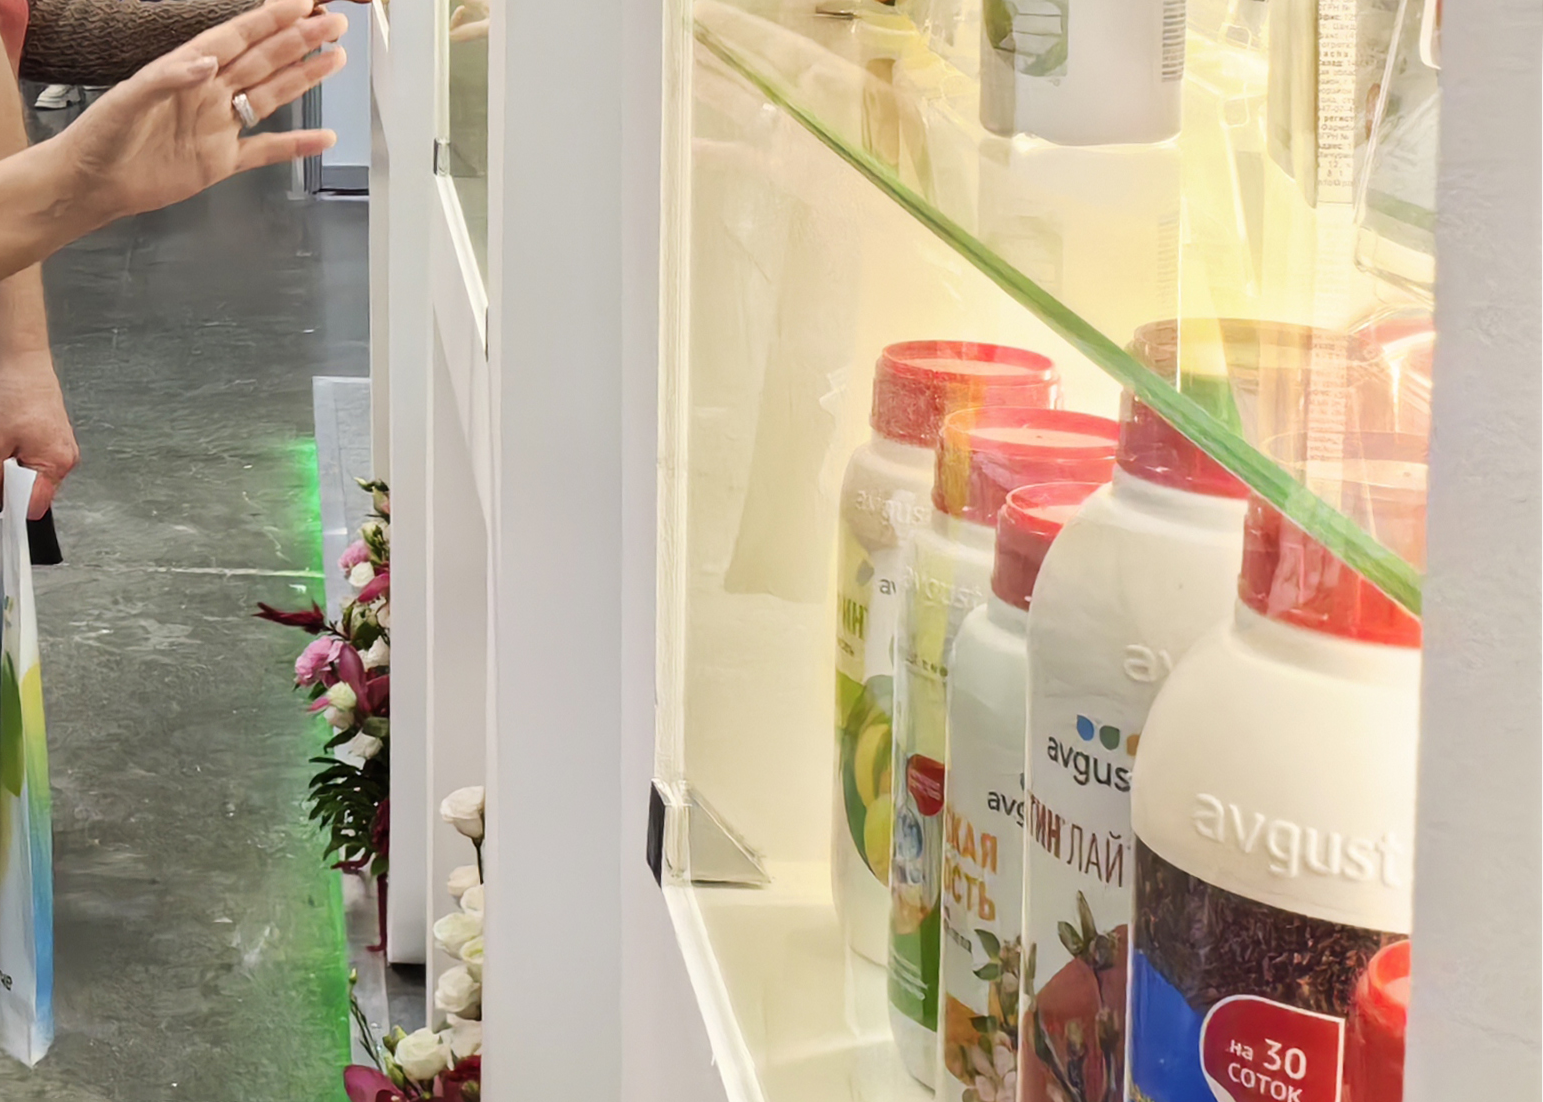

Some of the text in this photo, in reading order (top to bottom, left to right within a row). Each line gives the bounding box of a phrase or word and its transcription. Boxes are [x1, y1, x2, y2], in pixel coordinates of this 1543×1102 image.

[1047, 736, 1131, 793] avgus
[1066, 823, 1131, 888] ЛАЙ
[1192, 792, 1405, 889] avgust
[1228, 1062, 1303, 1102] СОТОК
[1230, 1038, 1307, 1080] на 30
